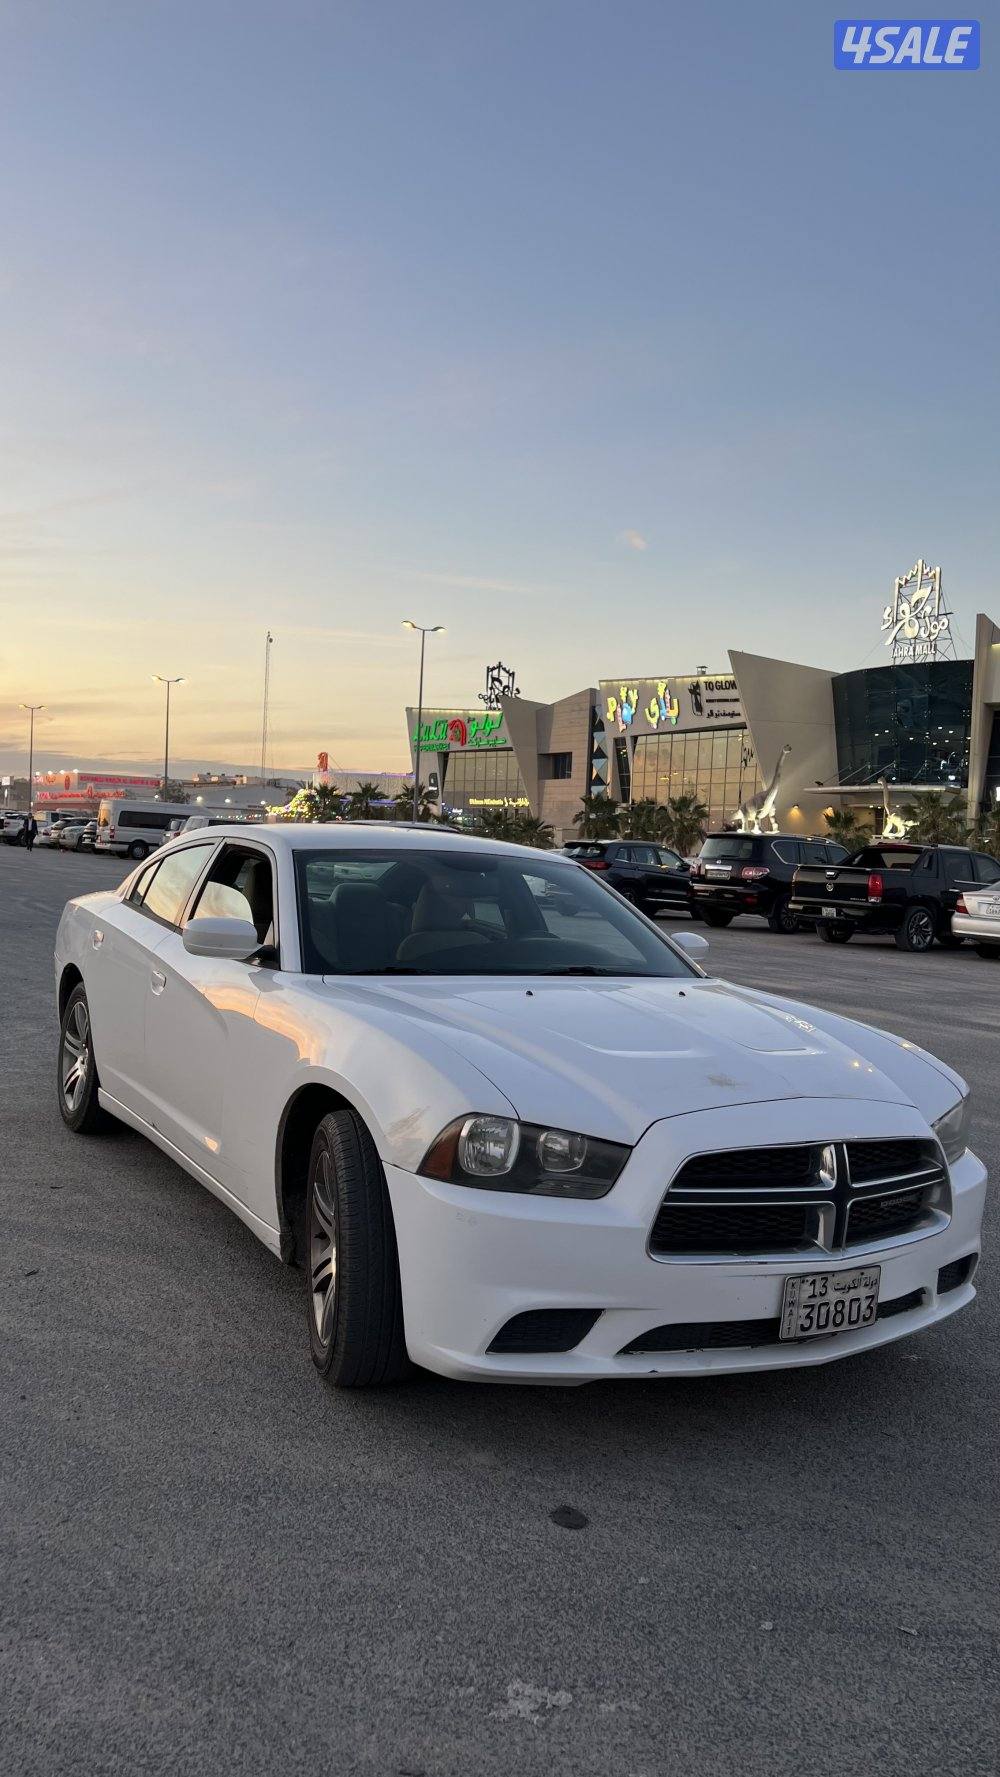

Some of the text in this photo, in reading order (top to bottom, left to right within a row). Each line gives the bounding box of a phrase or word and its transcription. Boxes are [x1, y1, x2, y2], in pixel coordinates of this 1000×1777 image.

[915, 643, 936, 656] MALL
[714, 680, 738, 691] GLOW
[807, 1276, 829, 1299] 13
[833, 1275, 878, 1293] دولة الكويت
[785, 1281, 797, 1336] KUWAIT
[800, 1294, 875, 1332] 30803
